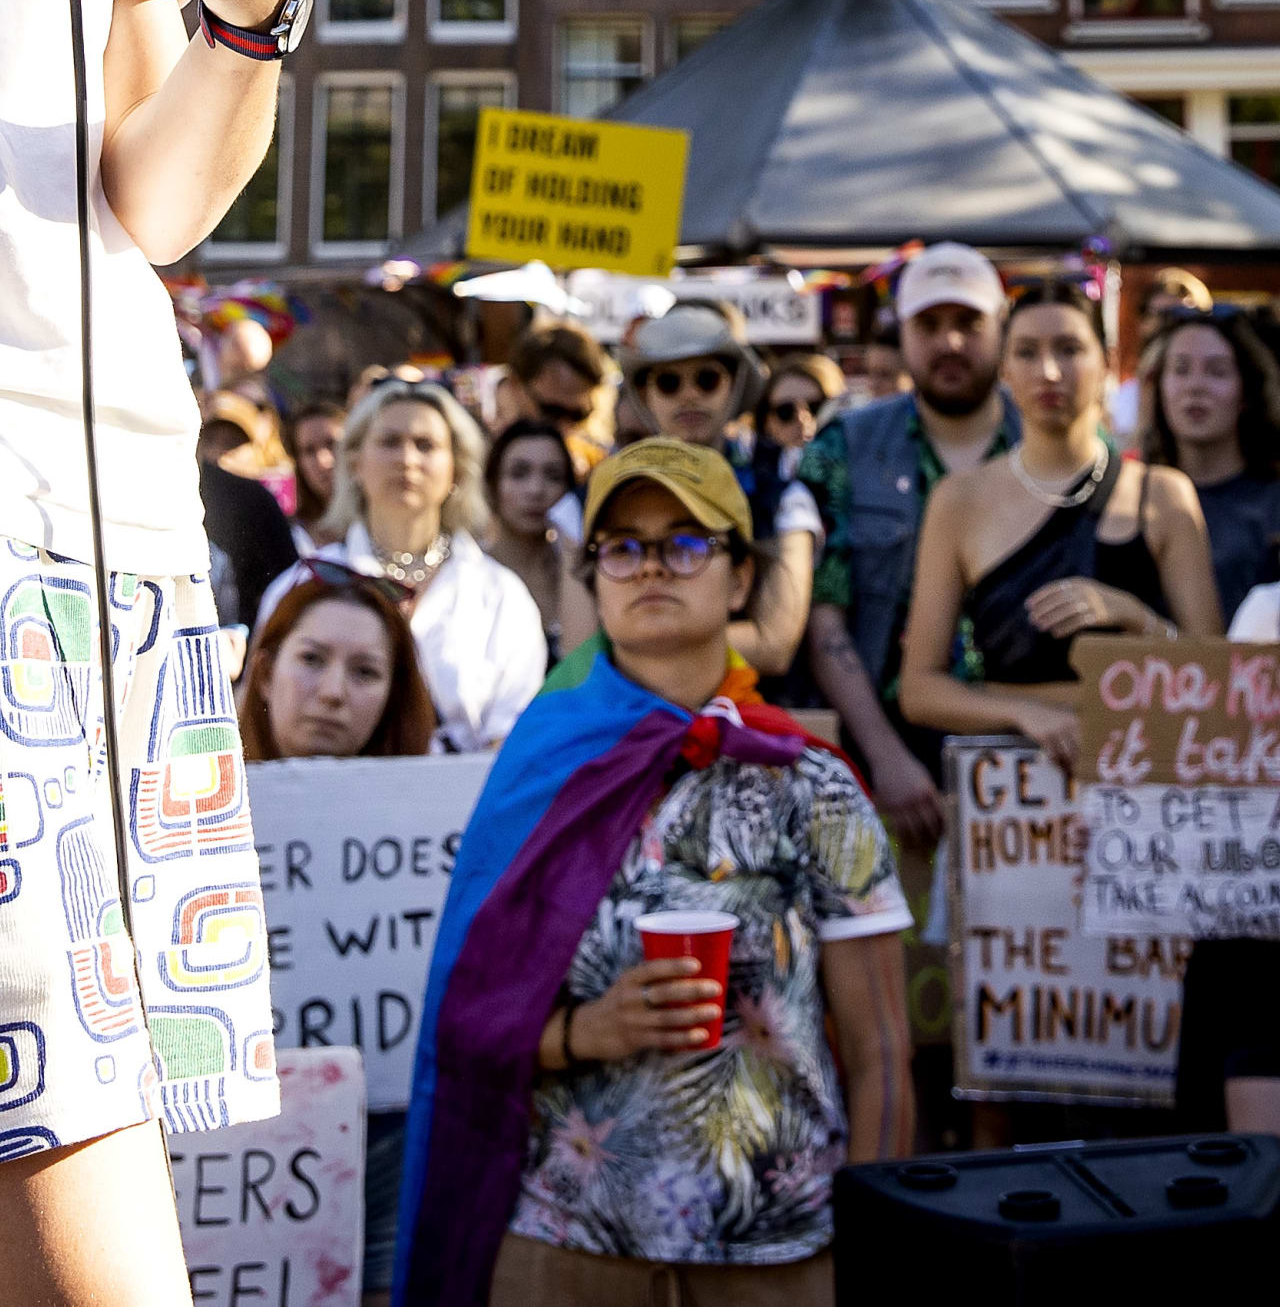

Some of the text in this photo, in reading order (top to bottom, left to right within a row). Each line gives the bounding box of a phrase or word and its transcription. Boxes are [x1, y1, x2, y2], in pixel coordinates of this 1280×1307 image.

[505, 123, 600, 160] DREAM
[485, 165, 644, 214] OF HOLDING
[480, 212, 632, 257] YOUR HAND
[1099, 655, 1220, 713] one
[1096, 717, 1154, 785] it
[1097, 787, 1141, 827] TO
[1161, 788, 1253, 833] GET
[1096, 829, 1179, 875] OUR
[969, 925, 1069, 976] THE
